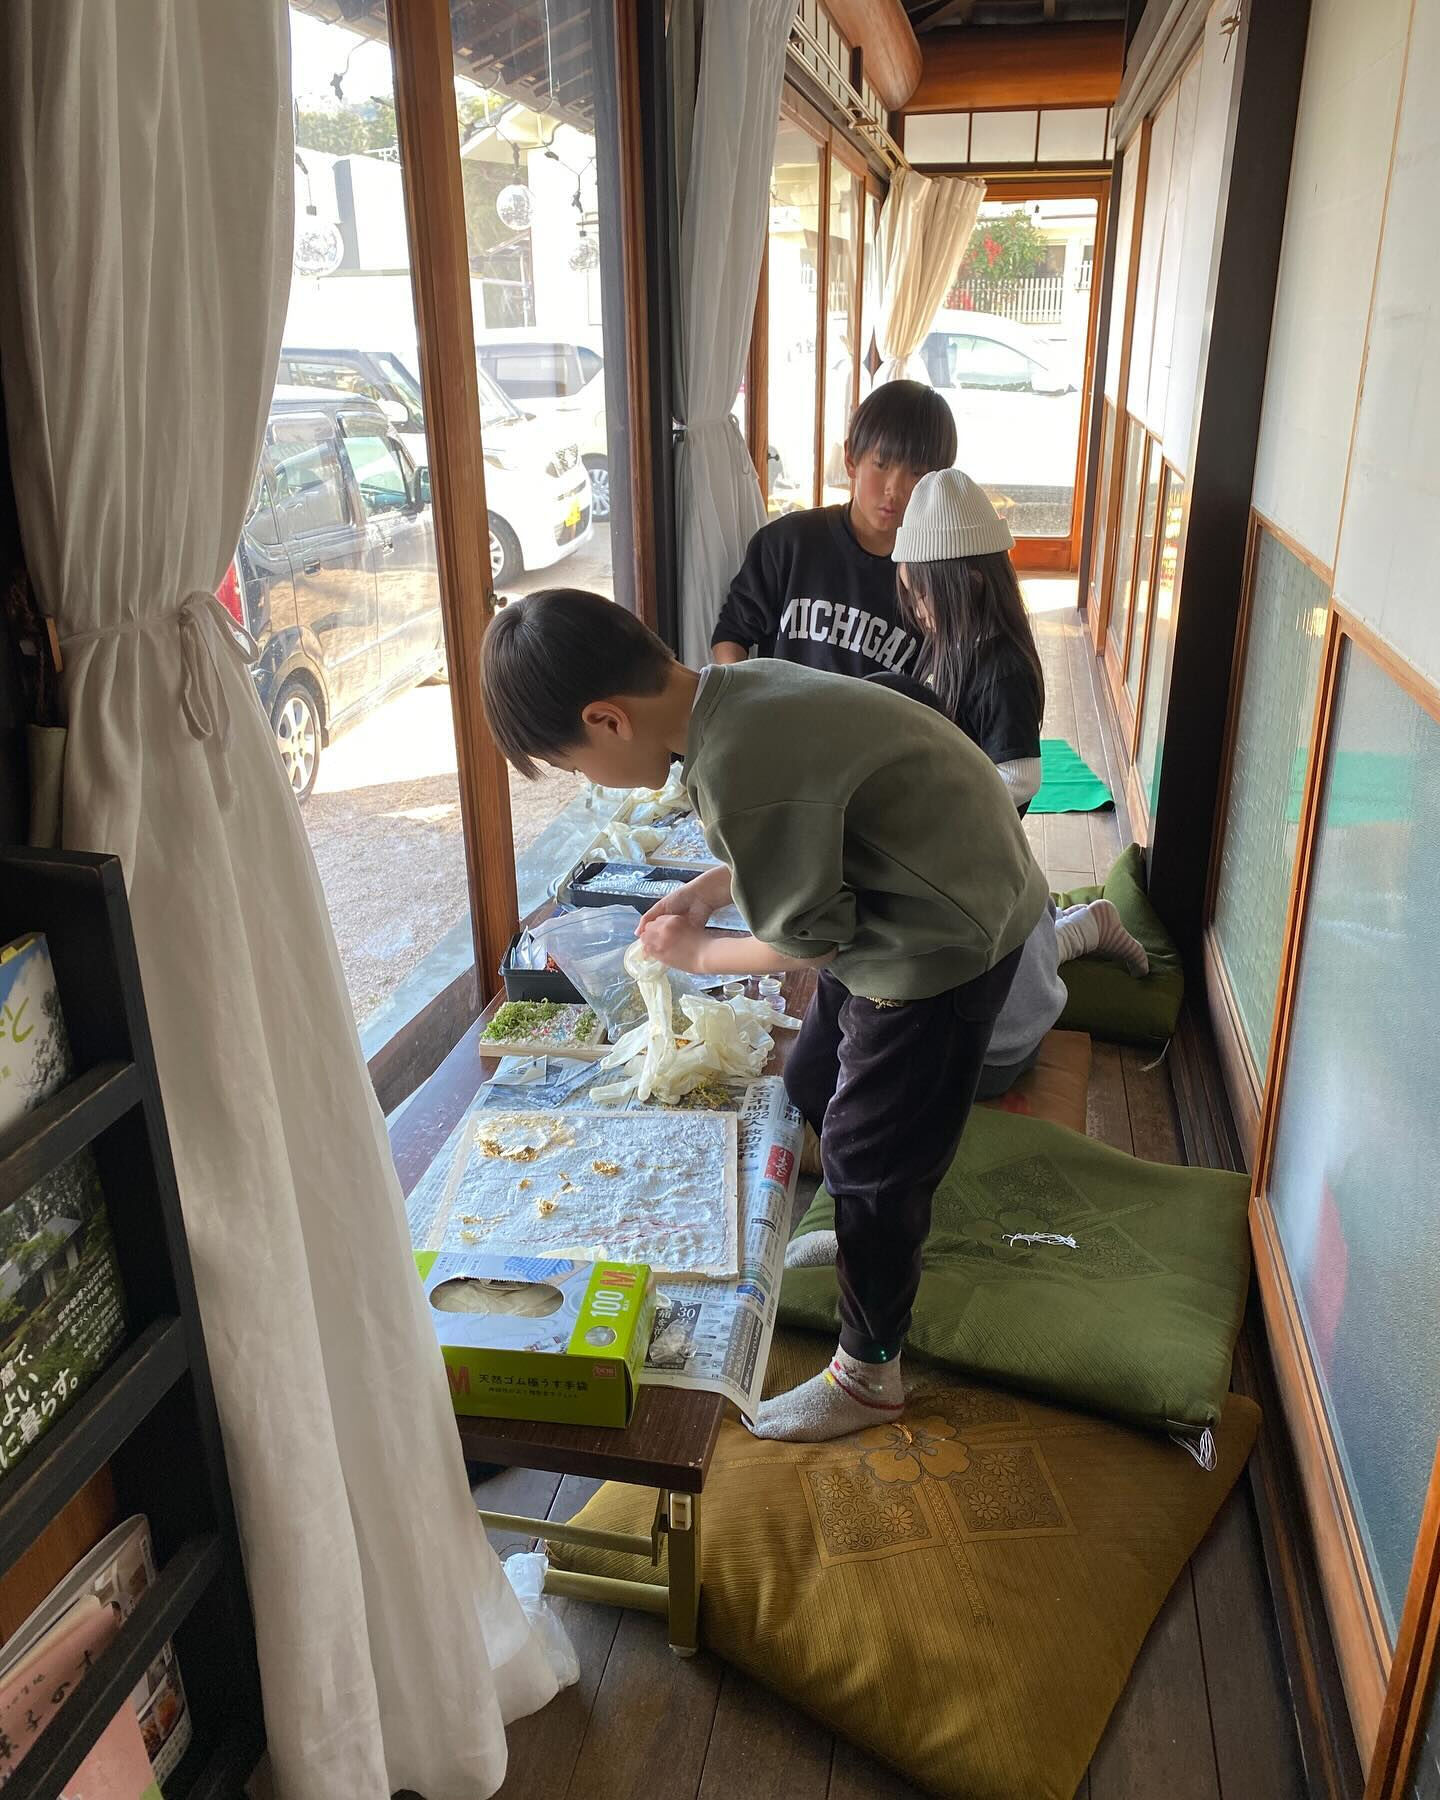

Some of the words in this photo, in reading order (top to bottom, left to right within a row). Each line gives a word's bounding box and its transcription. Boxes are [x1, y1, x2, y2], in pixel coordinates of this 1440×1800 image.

[601, 1271, 638, 1289] M
[590, 1290, 625, 1318] 100
[447, 1365, 471, 1395] M
[0, 1373, 38, 1434] よい
